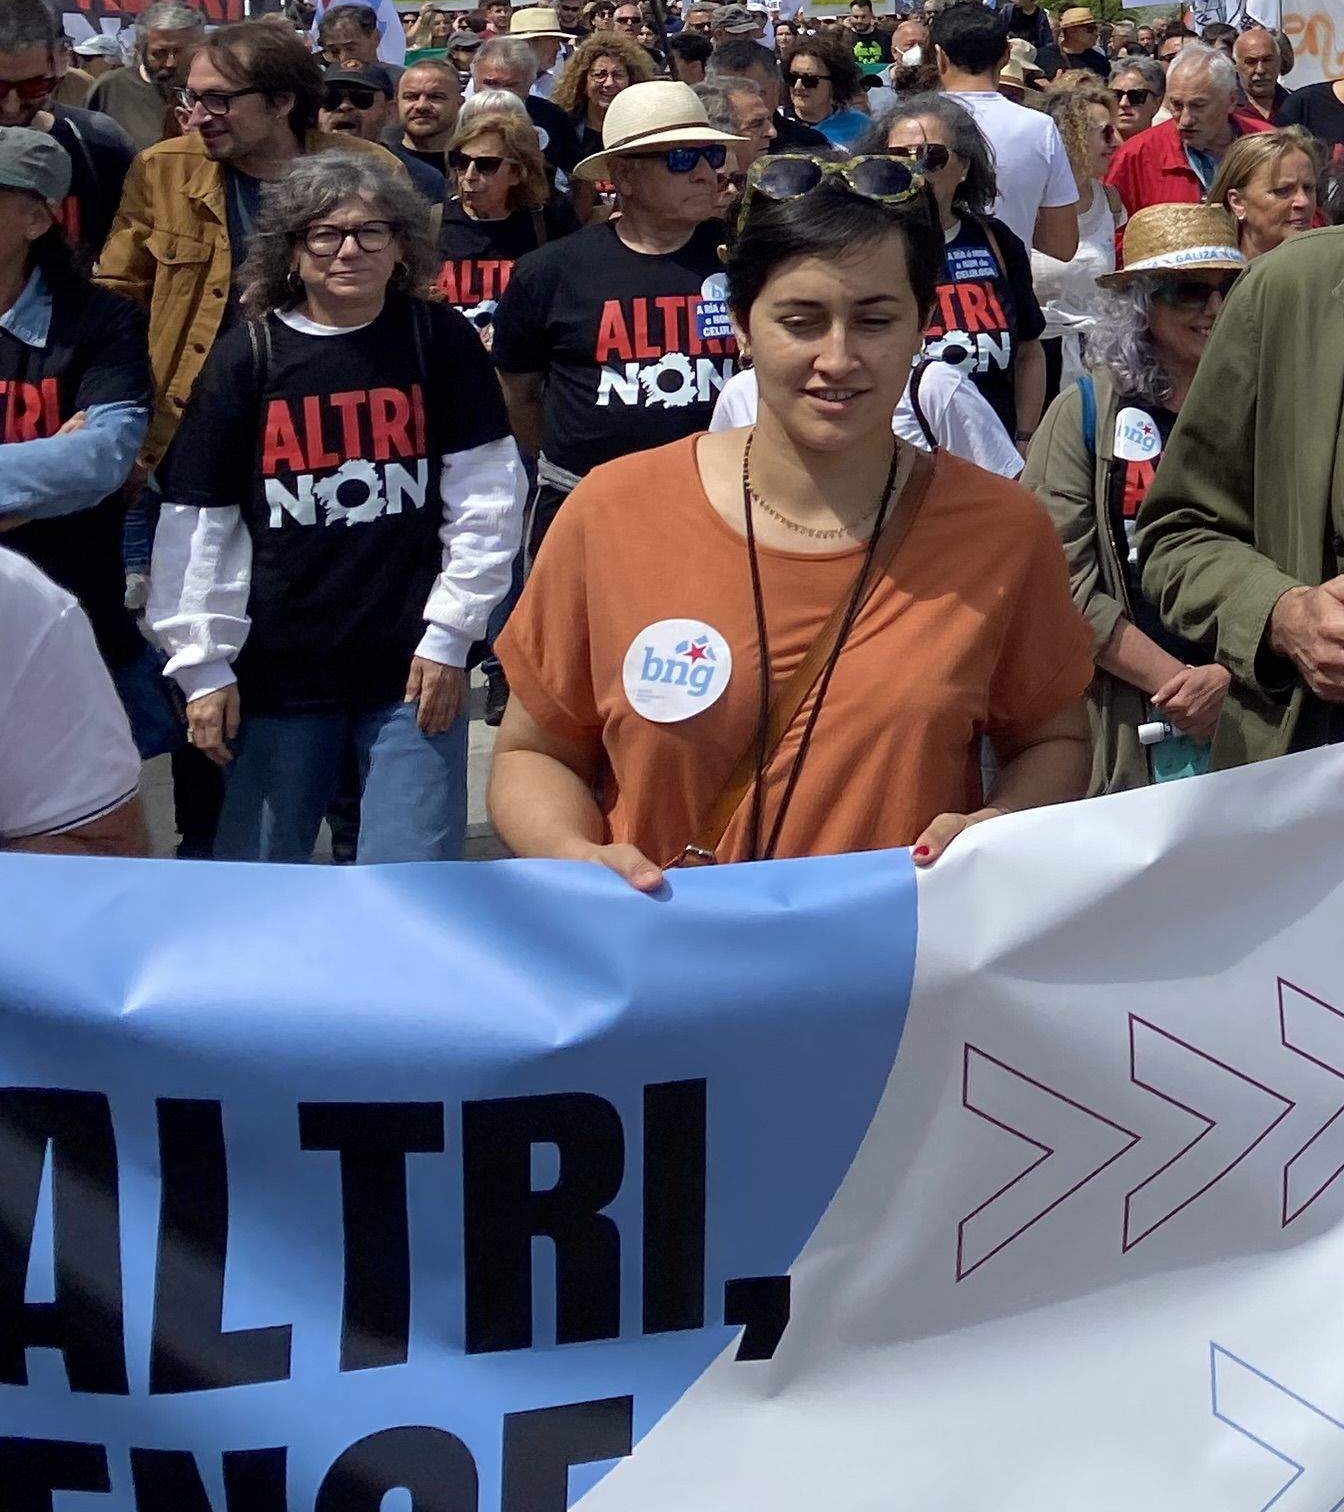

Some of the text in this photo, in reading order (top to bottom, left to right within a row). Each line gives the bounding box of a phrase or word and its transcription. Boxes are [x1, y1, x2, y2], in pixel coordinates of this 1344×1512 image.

[1175, 250, 1217, 263] GALIZA
[924, 282, 1009, 336] TRI
[595, 351, 734, 409] NON
[911, 330, 1011, 372] ON
[0, 379, 59, 442] RI
[262, 383, 425, 475] ALTRI
[265, 458, 428, 527] NON
[641, 646, 716, 697] bng
[0, 1077, 792, 1396] ALTRI,
